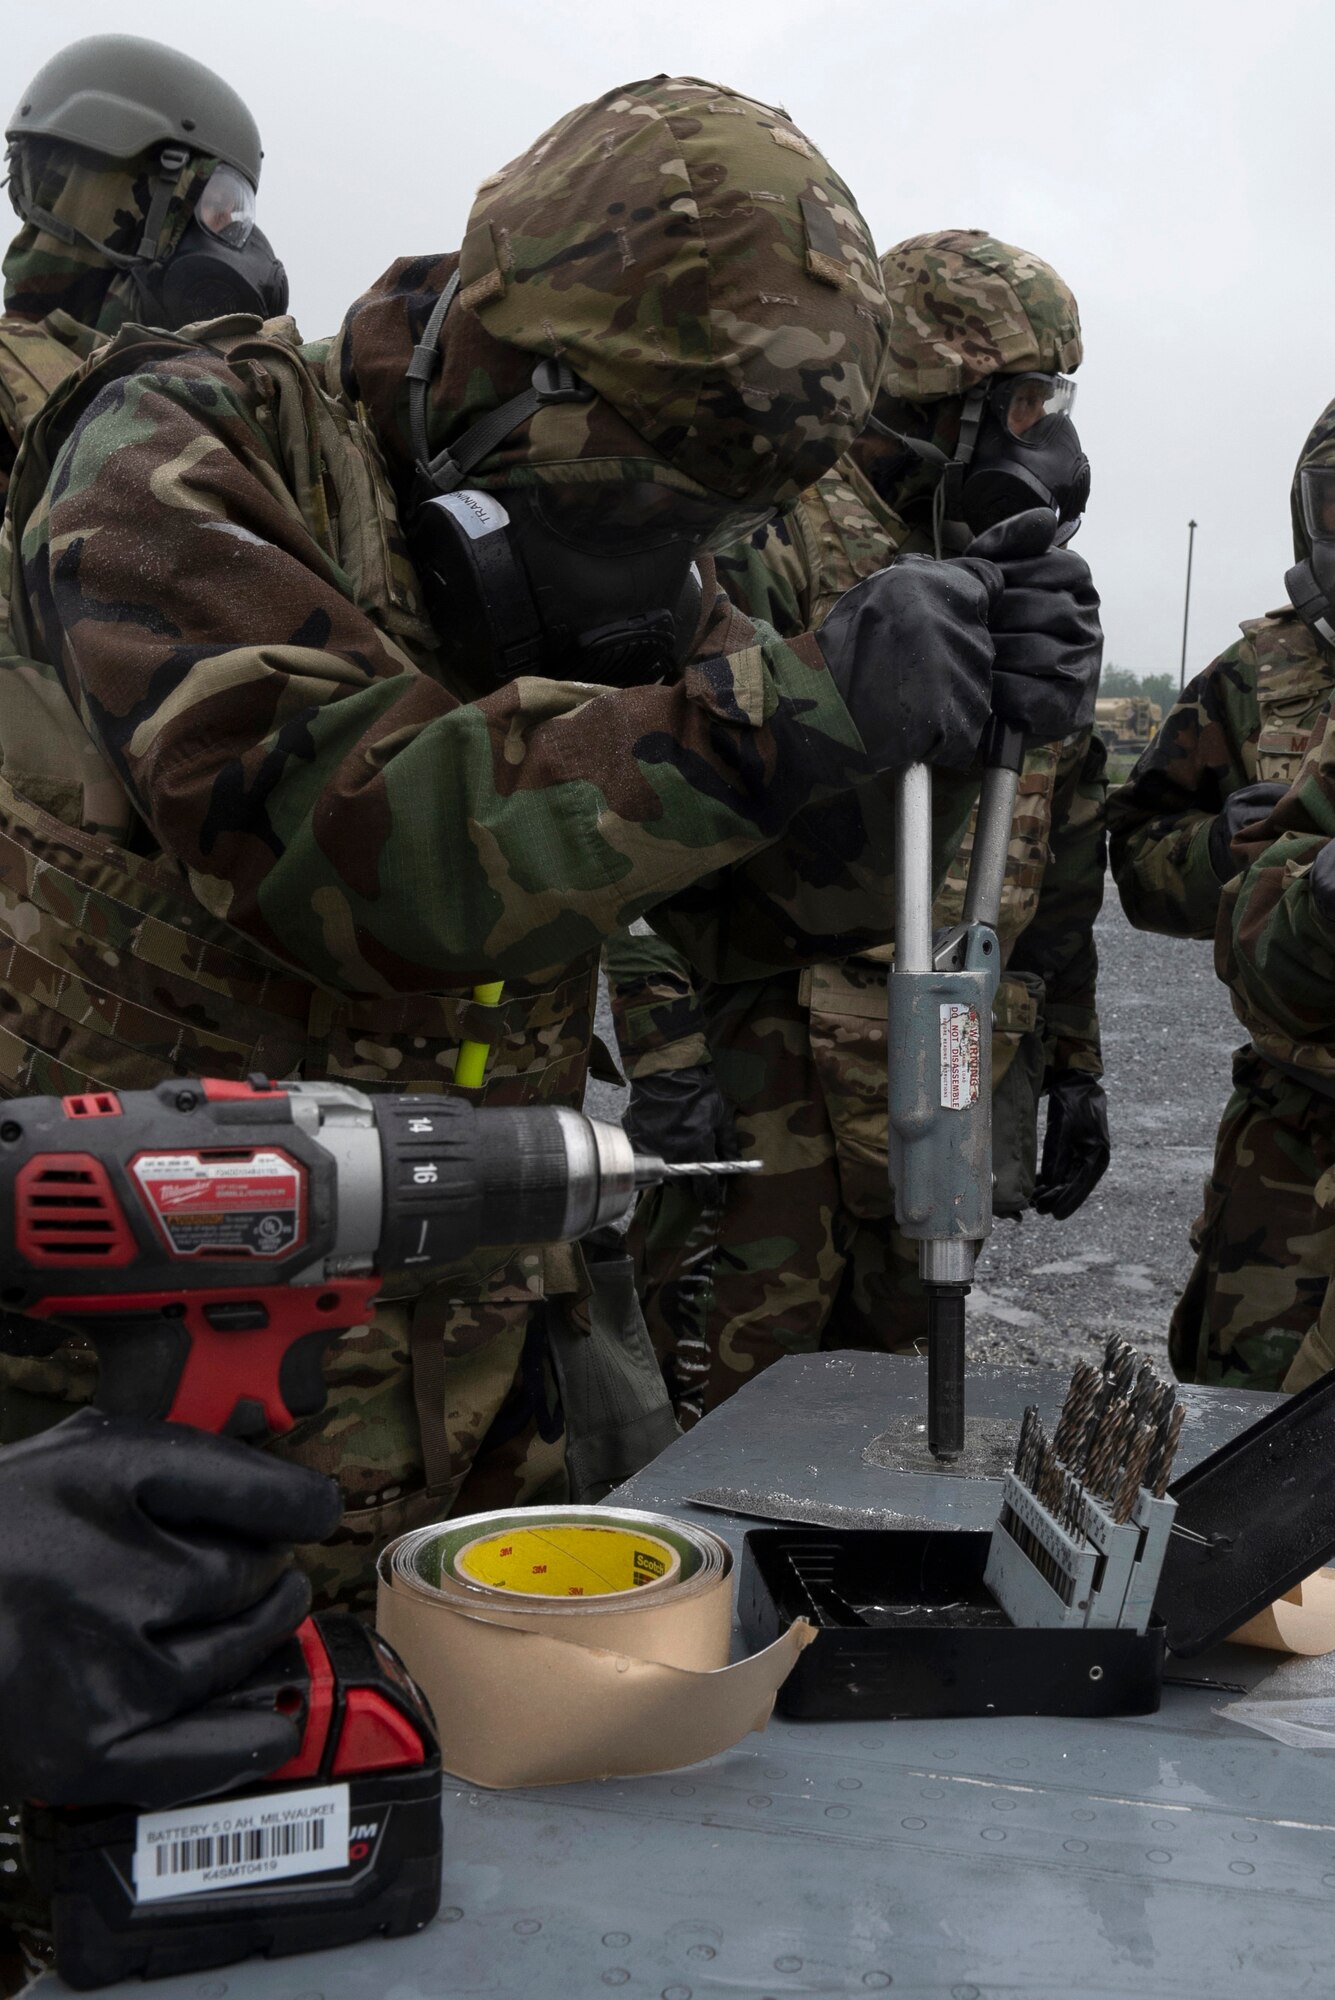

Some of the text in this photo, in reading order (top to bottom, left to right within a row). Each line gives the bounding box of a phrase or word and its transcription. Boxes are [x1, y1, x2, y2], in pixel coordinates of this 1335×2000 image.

[449, 491, 491, 524] TRAINING
[951, 1006, 960, 1108] DO NOT DISASSEMBLE
[969, 1028, 978, 1086] WARNING
[407, 1116, 434, 1133] 14
[413, 1162, 438, 1184] 16
[499, 1546, 513, 1557] 3M
[532, 1565, 547, 1575] 3M
[636, 1554, 664, 1575] Scotch
[568, 1587, 584, 1596] 3M
[147, 1822, 209, 1844] BATTERY
[202, 1861, 278, 1882] K4SMT0419
